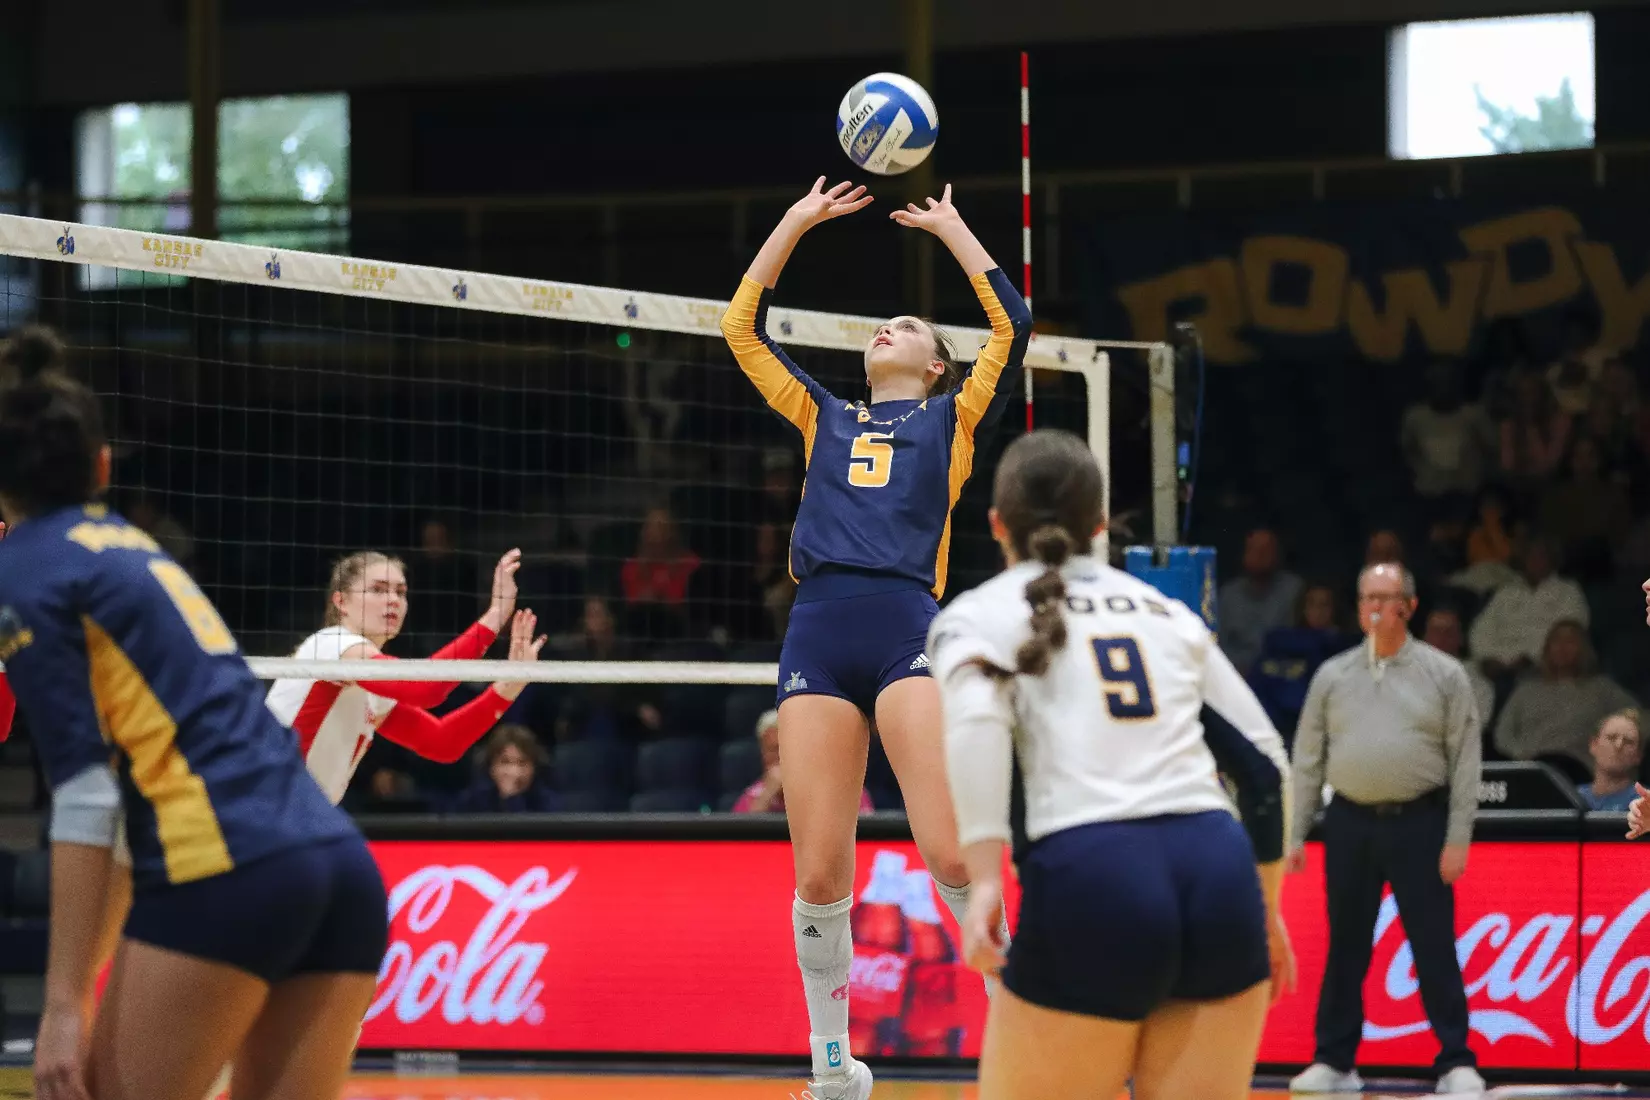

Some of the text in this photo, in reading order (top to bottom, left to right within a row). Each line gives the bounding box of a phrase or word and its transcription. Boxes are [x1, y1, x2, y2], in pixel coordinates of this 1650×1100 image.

[842, 101, 874, 149] molten
[142, 237, 203, 257] KANSAS
[154, 253, 190, 269] CITY
[1117, 206, 1650, 366] ROWDY
[848, 432, 894, 487] 5
[1087, 633, 1159, 723] 9
